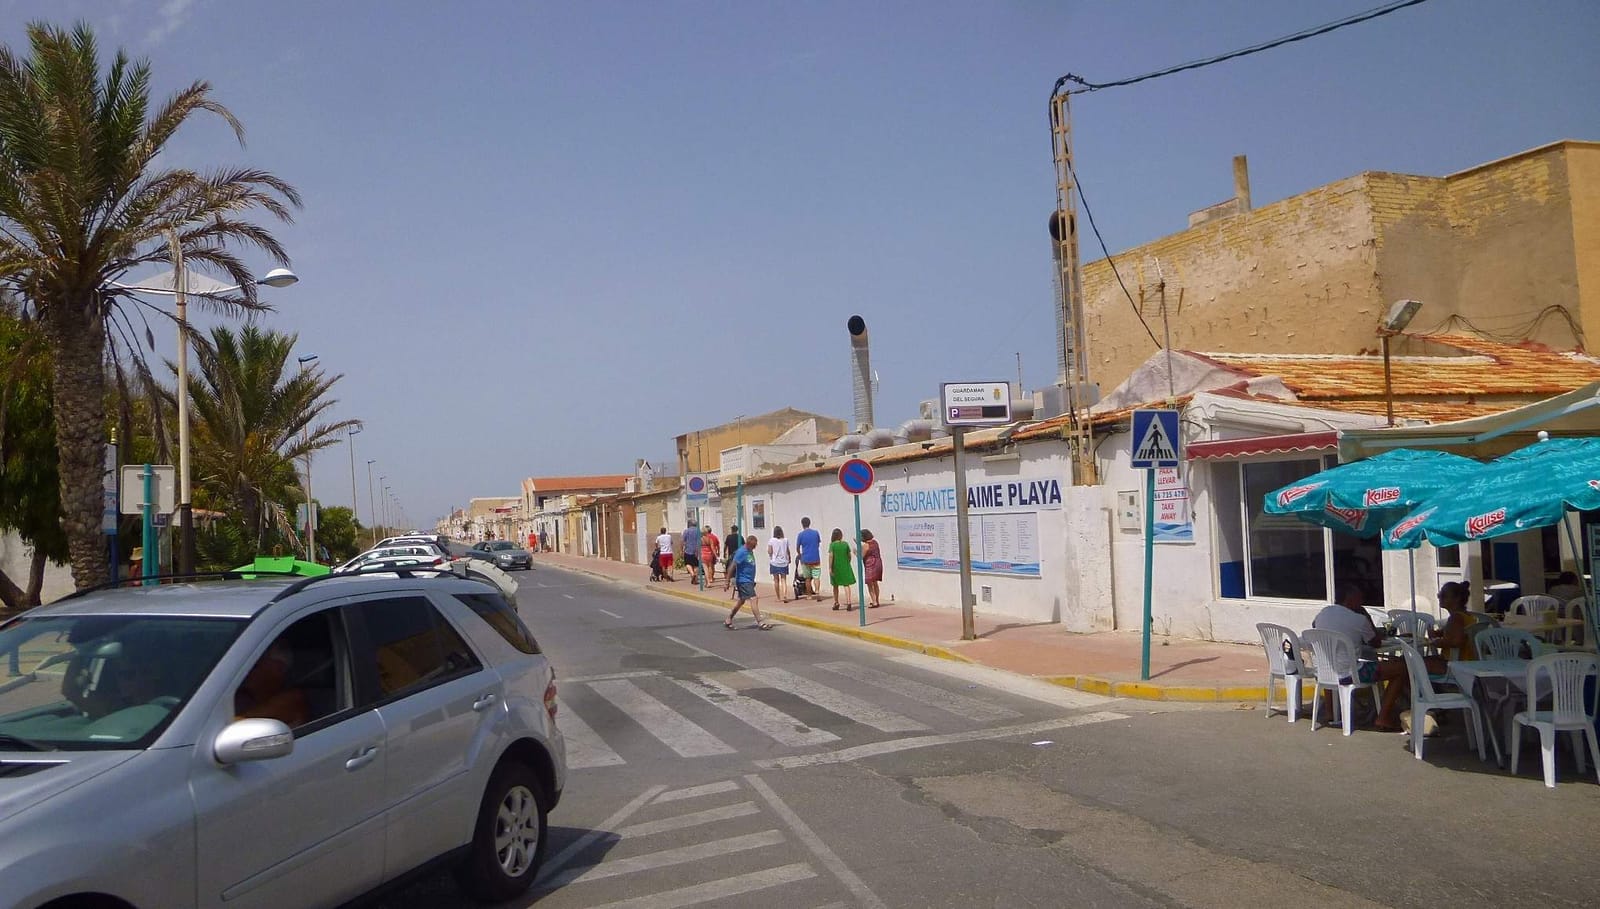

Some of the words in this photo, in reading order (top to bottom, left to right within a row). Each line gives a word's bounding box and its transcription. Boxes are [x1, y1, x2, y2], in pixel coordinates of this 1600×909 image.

[951, 408, 959, 418] P
[1157, 476, 1176, 485] LLEVAR
[880, 488, 955, 513] RESTAURANTE
[967, 484, 1003, 508] AIME
[1008, 479, 1062, 506] PLAYA
[1365, 488, 1400, 507] Kalise
[1160, 512, 1176, 520] AWAY
[1467, 508, 1506, 538] Kalise
